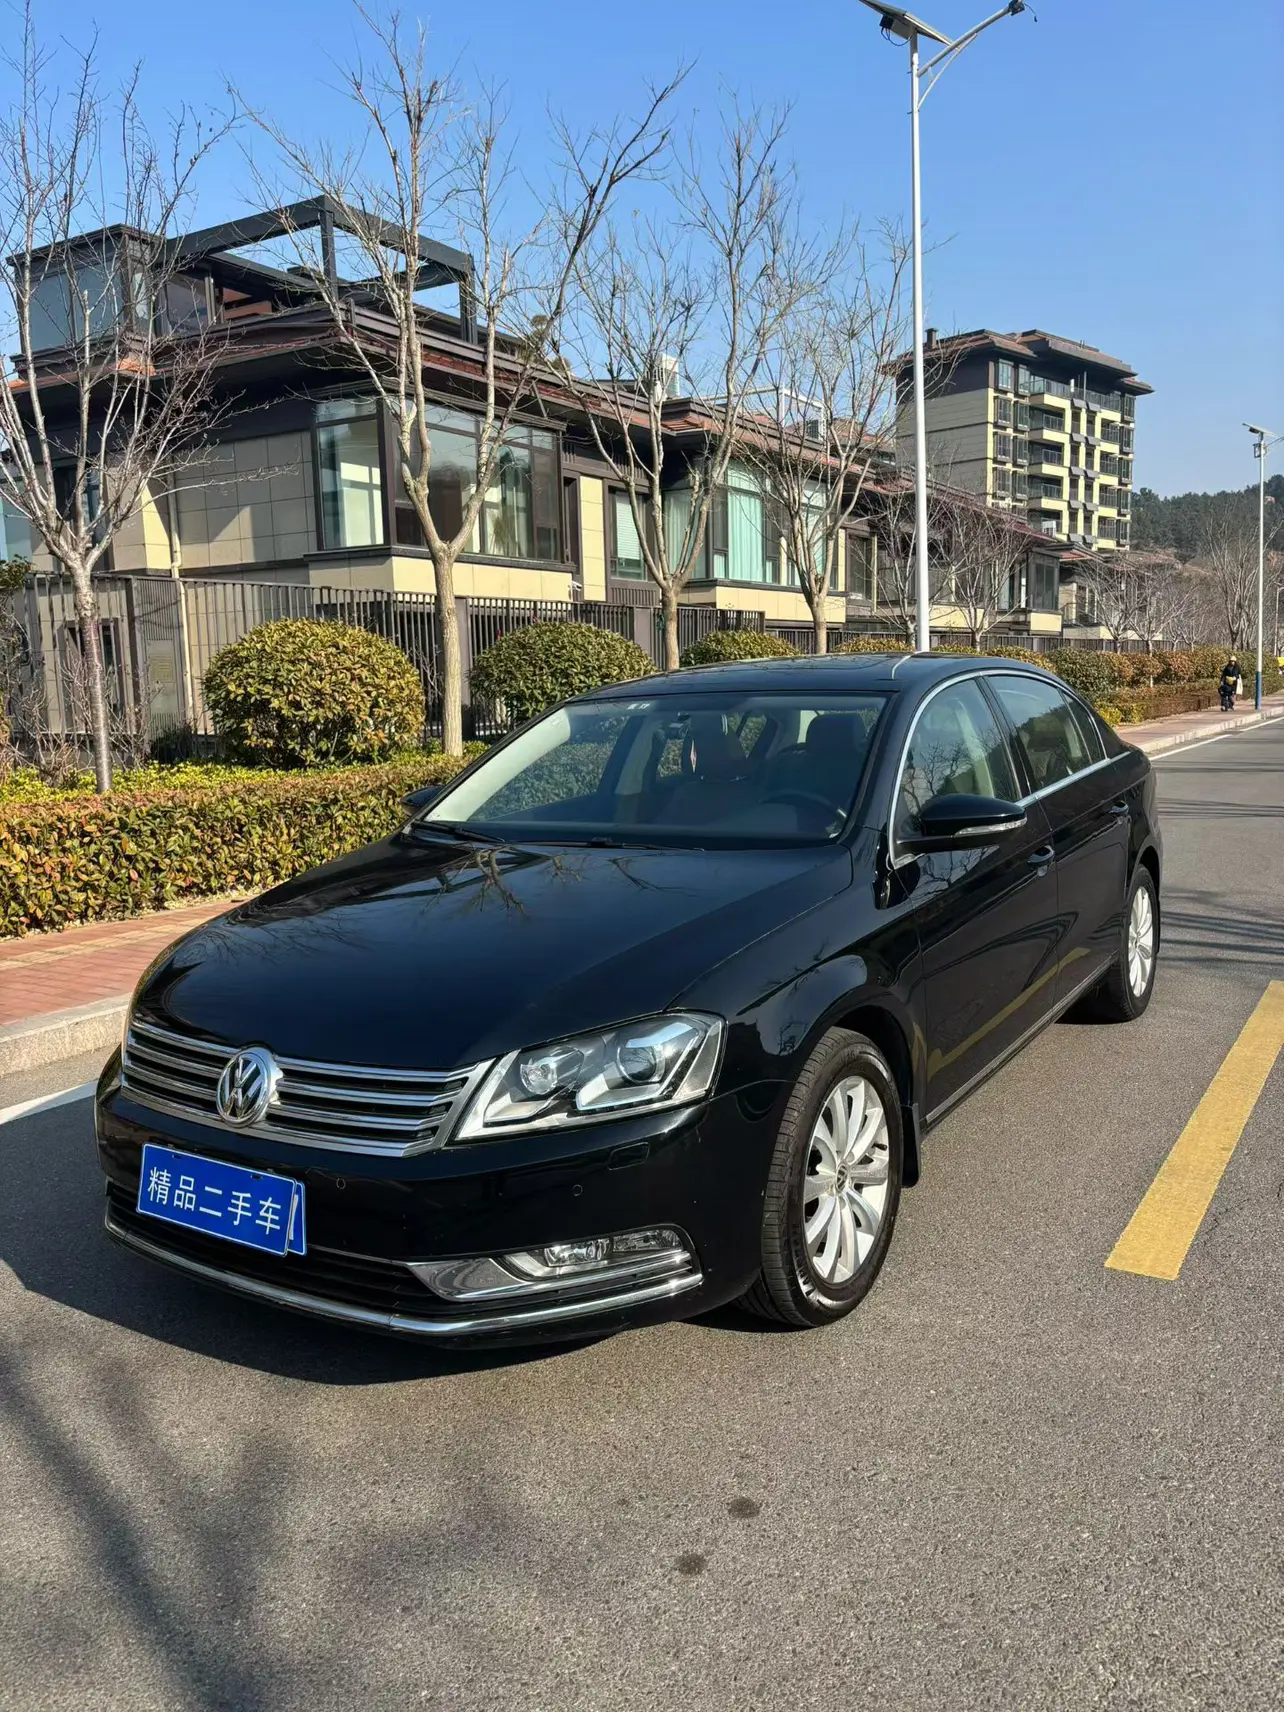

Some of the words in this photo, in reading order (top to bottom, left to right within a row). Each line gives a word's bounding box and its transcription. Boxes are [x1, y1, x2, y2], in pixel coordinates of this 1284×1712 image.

[147, 1166, 281, 1235] 精品二手车
